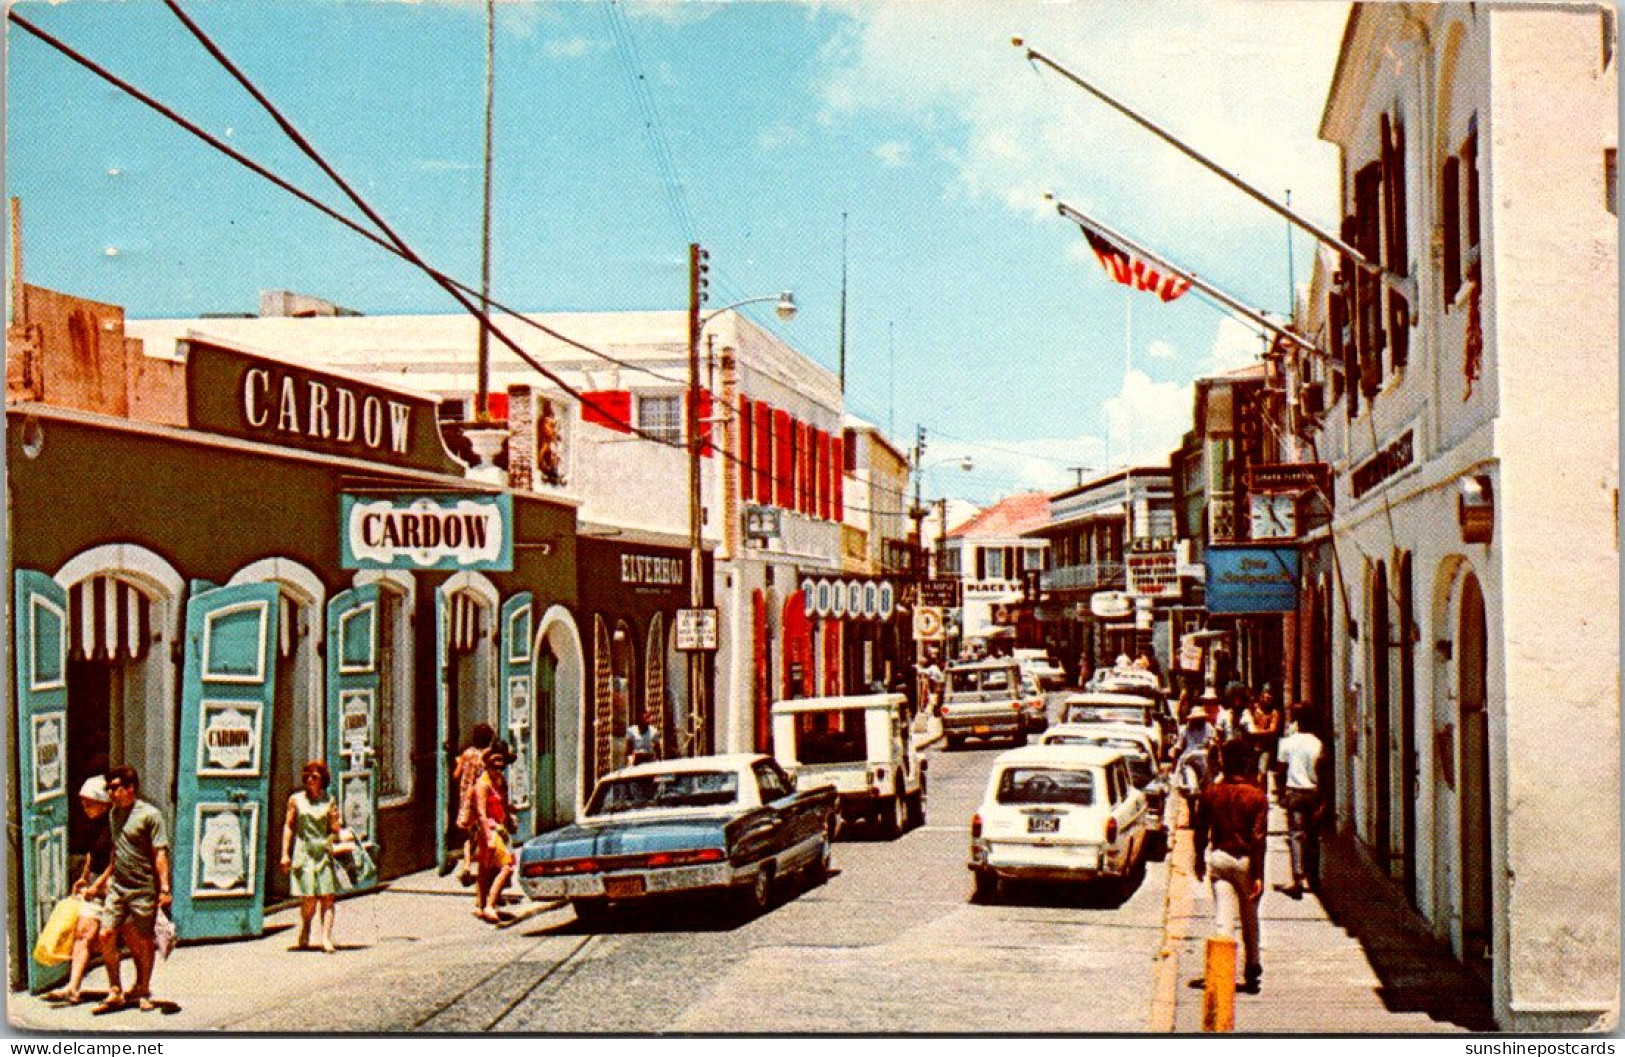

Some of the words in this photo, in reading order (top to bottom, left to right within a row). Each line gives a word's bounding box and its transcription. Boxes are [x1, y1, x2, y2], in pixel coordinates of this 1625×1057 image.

[244, 368, 411, 454] CARDOW
[361, 512, 489, 549] CARDOW
[621, 554, 683, 584] ELVERHOJ
[967, 584, 1005, 592] PLACE
